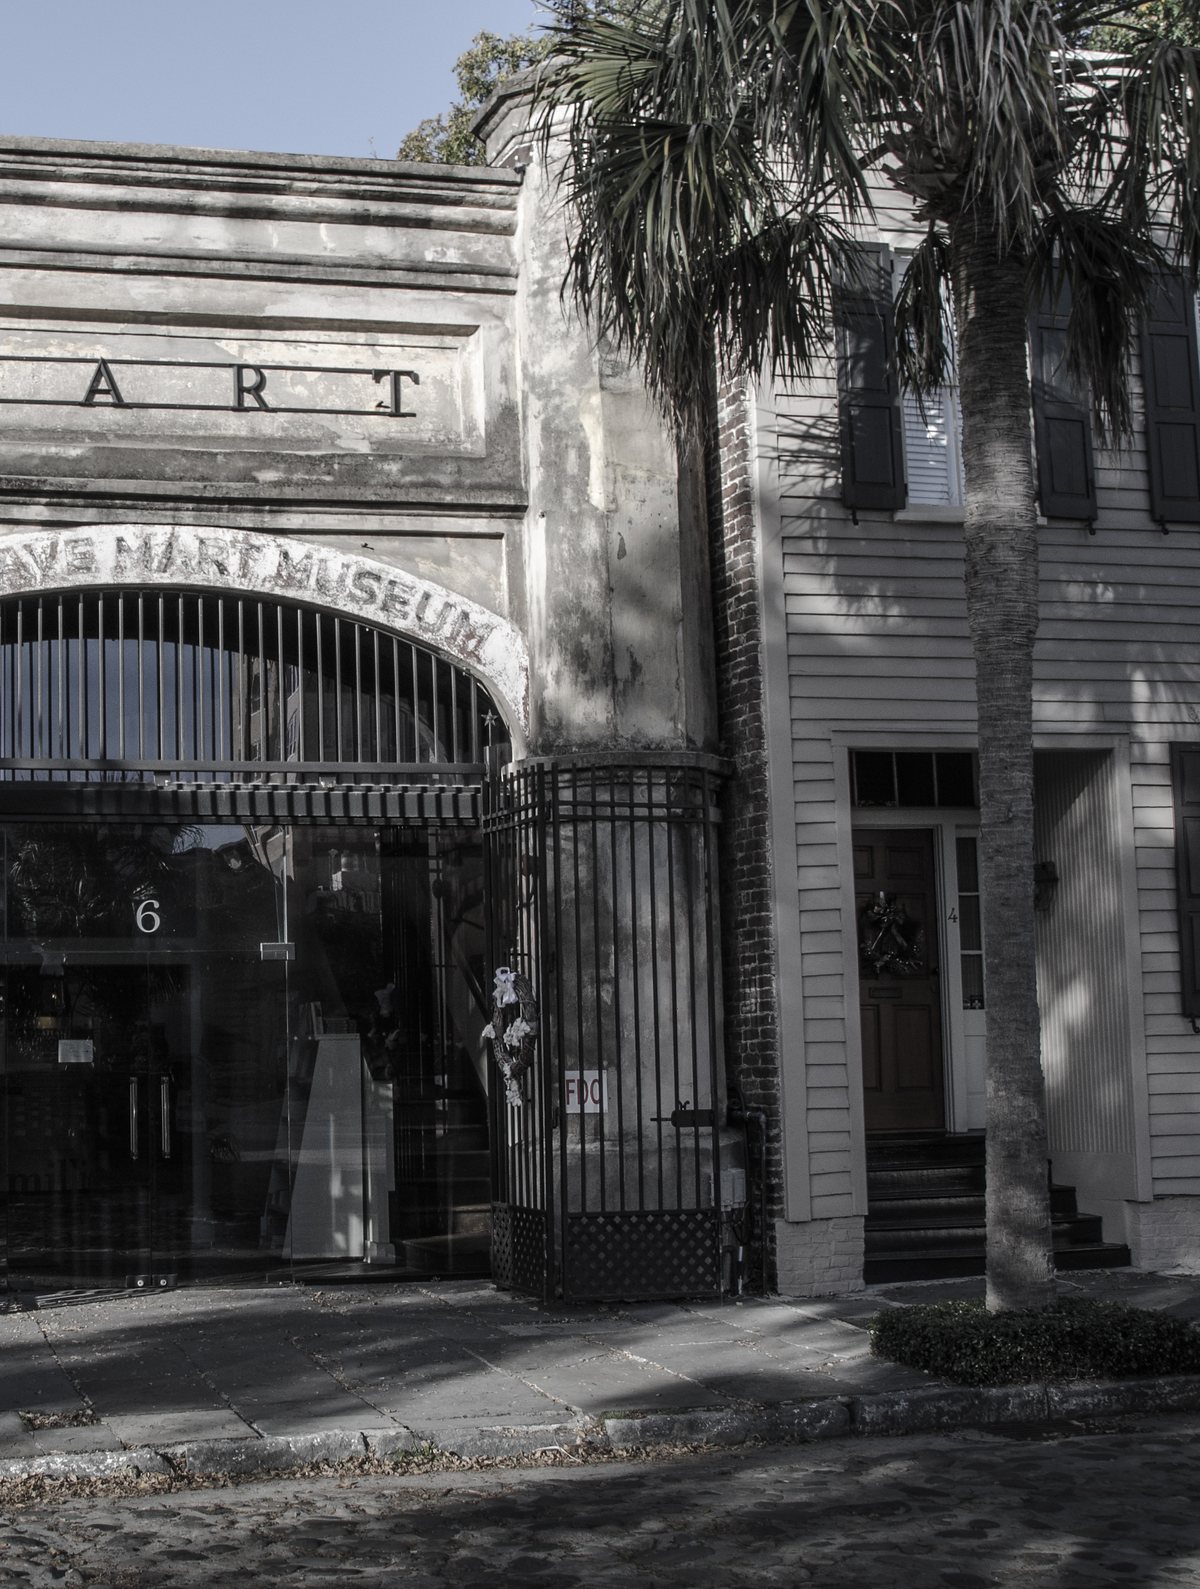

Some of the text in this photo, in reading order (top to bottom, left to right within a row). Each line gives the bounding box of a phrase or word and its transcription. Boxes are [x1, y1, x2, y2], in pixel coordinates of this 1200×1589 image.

[113, 527, 264, 580] MART
[274, 548, 496, 667] MUSEUM
[135, 899, 161, 933] 6
[947, 907, 958, 923] 4
